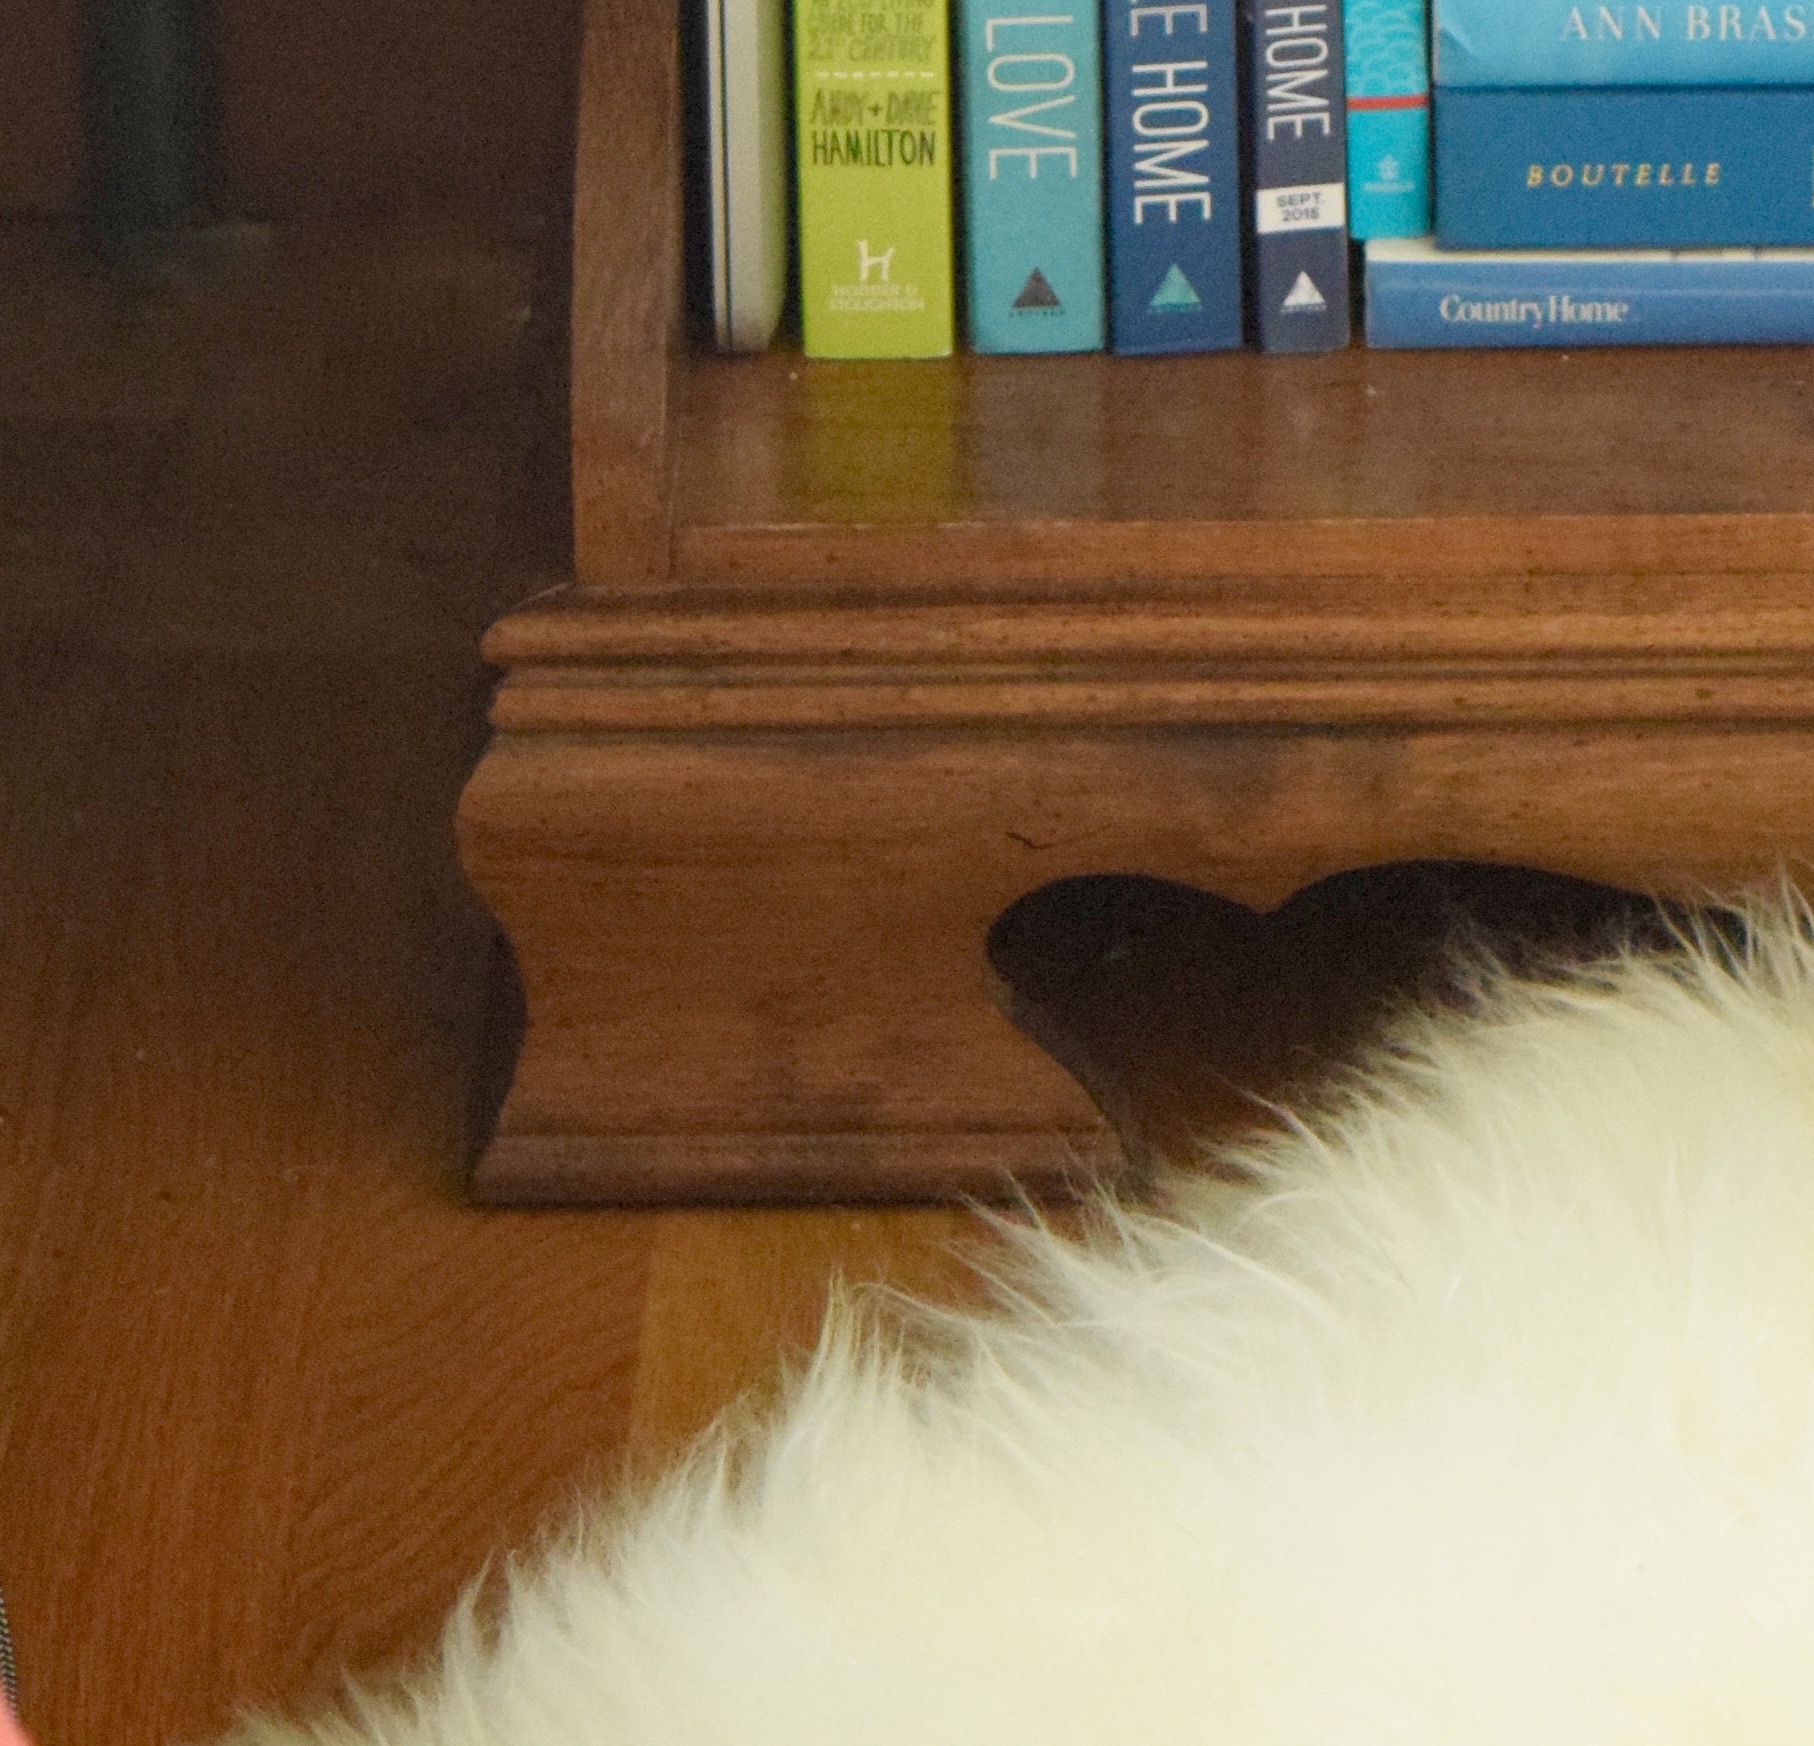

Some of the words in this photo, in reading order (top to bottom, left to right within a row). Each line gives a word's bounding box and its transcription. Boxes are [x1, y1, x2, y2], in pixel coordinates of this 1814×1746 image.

[1561, 5, 1663, 42] ANN
[985, 15, 1078, 180] LOVE
[1264, 3, 1331, 141] HOME
[811, 128, 936, 167] HAMILTON
[1131, 60, 1213, 225] HOME
[1526, 160, 1723, 188] BOUTELLE
